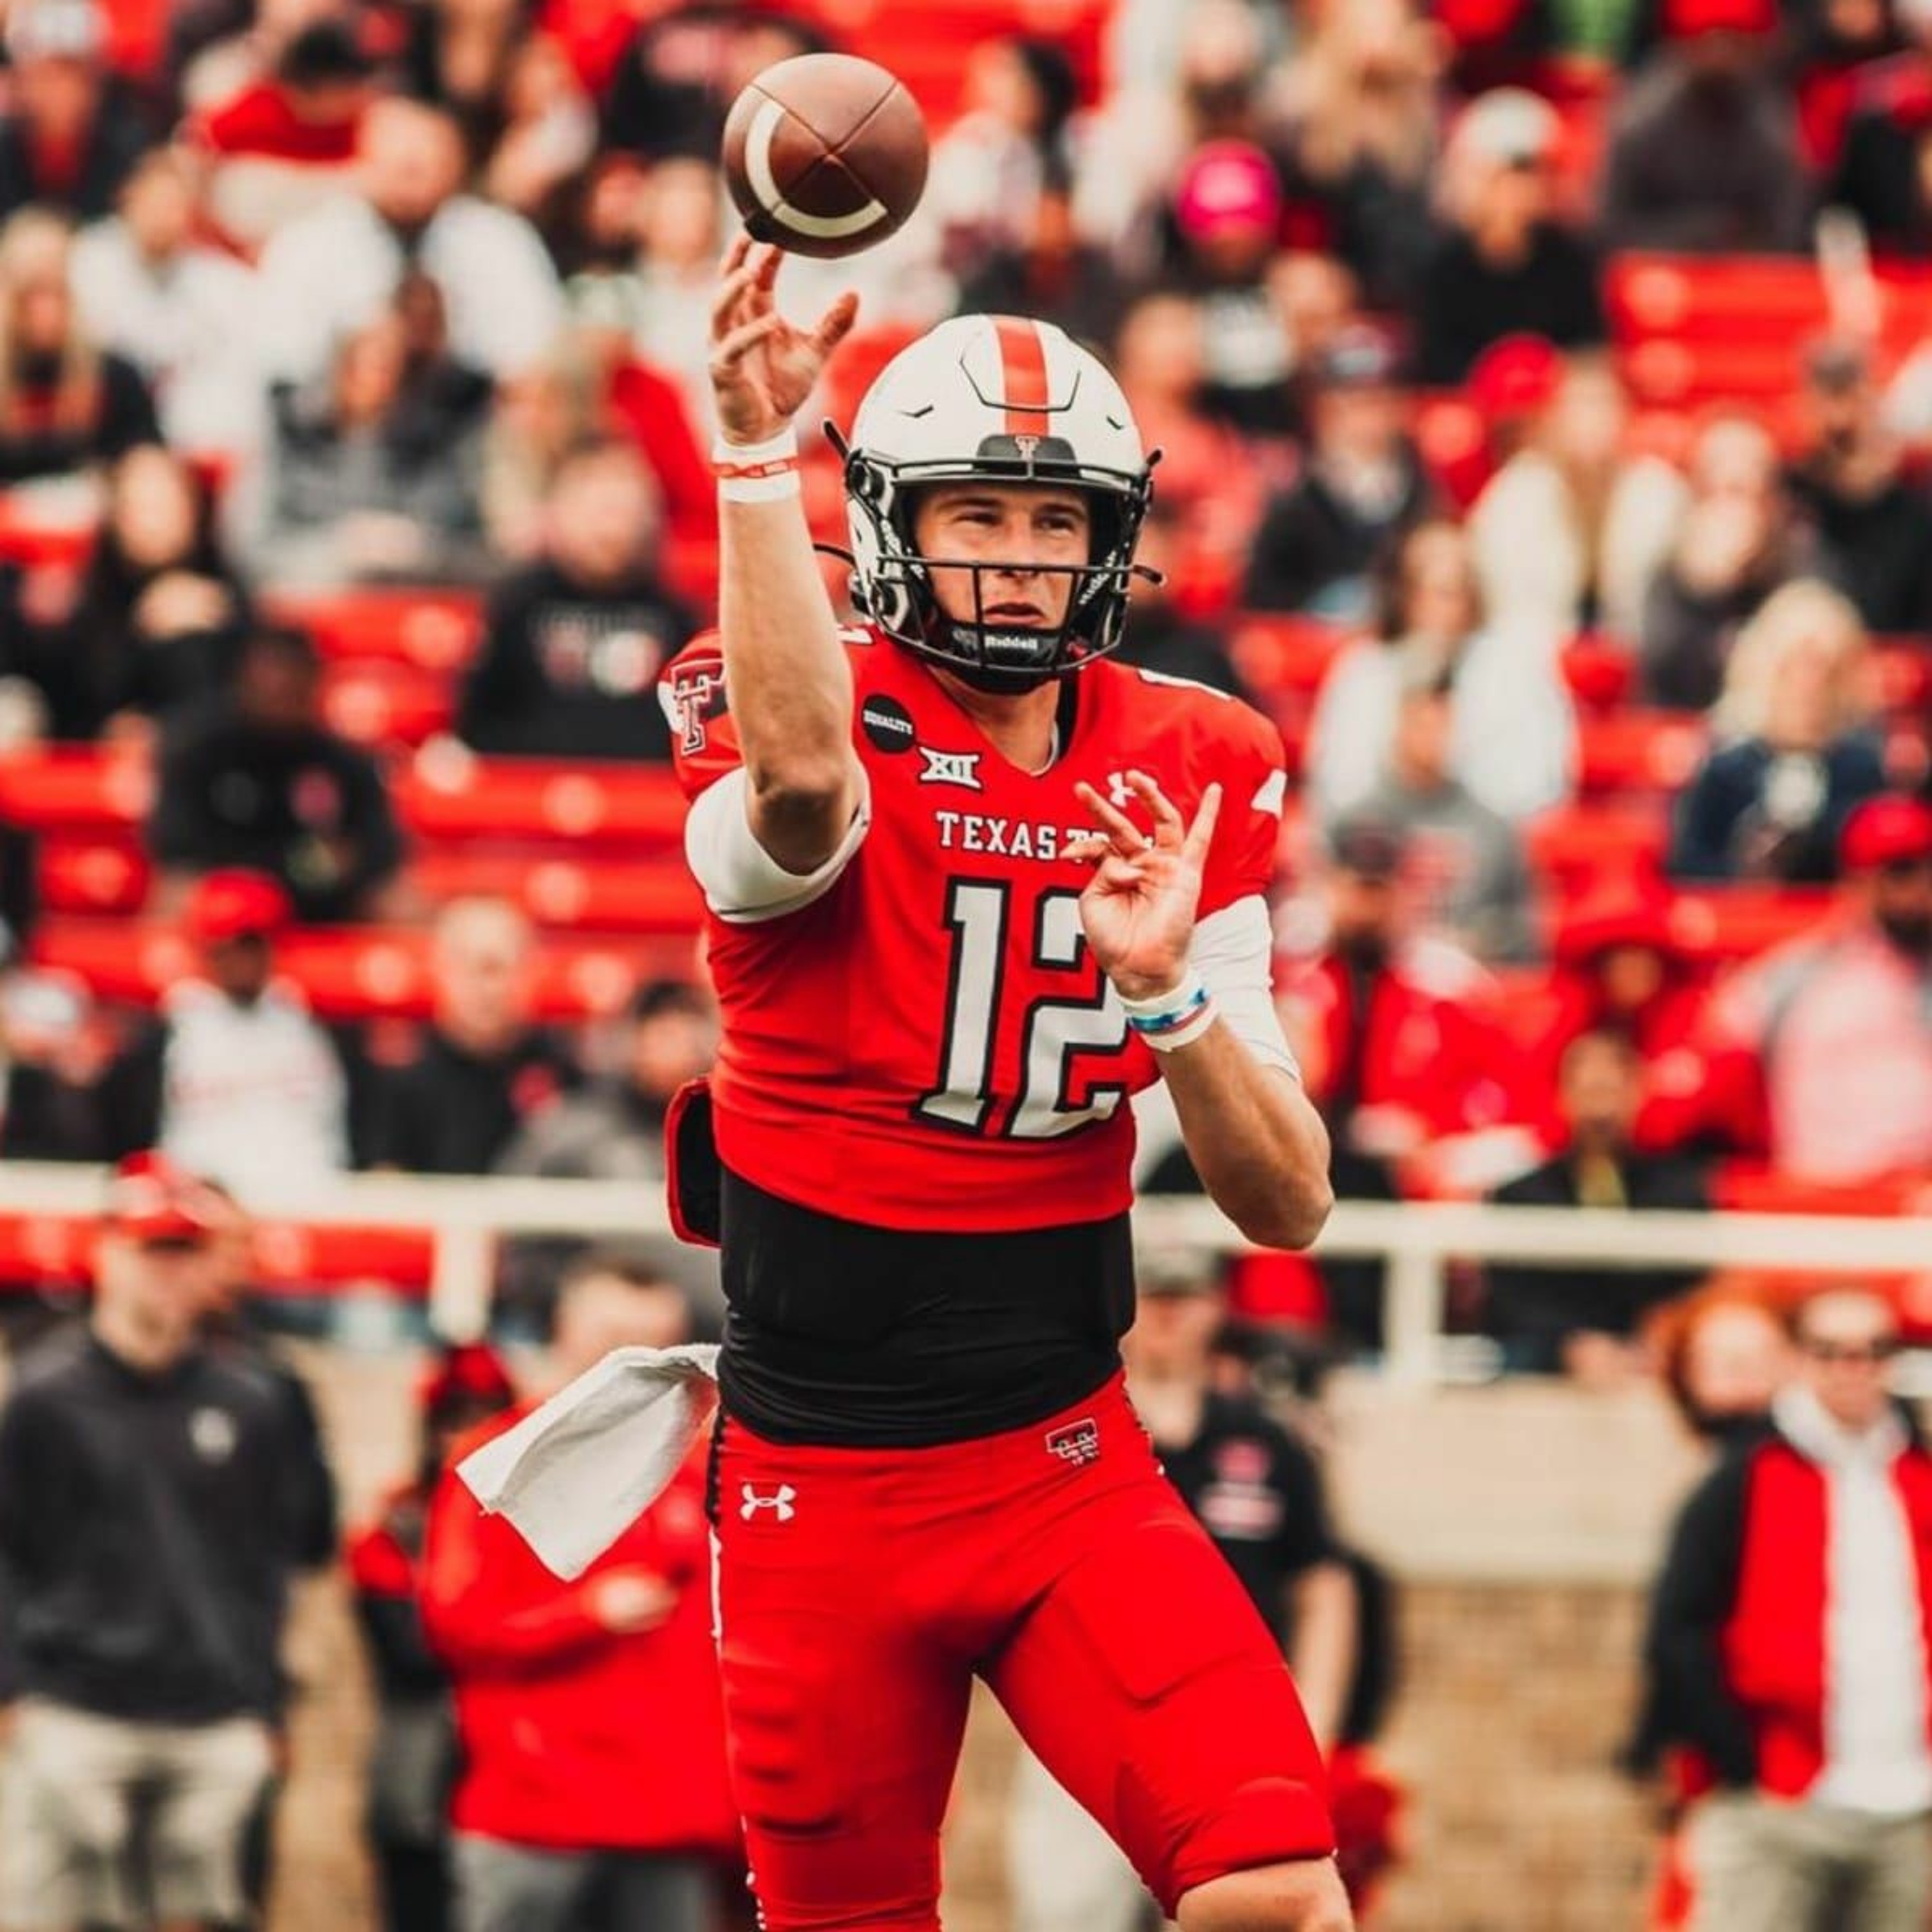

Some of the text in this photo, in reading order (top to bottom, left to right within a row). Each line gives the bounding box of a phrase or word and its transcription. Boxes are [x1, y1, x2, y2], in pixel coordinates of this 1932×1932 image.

[919, 746, 982, 789] XII
[935, 810, 1057, 860] TEXAS
[913, 876, 1128, 1139] 12
